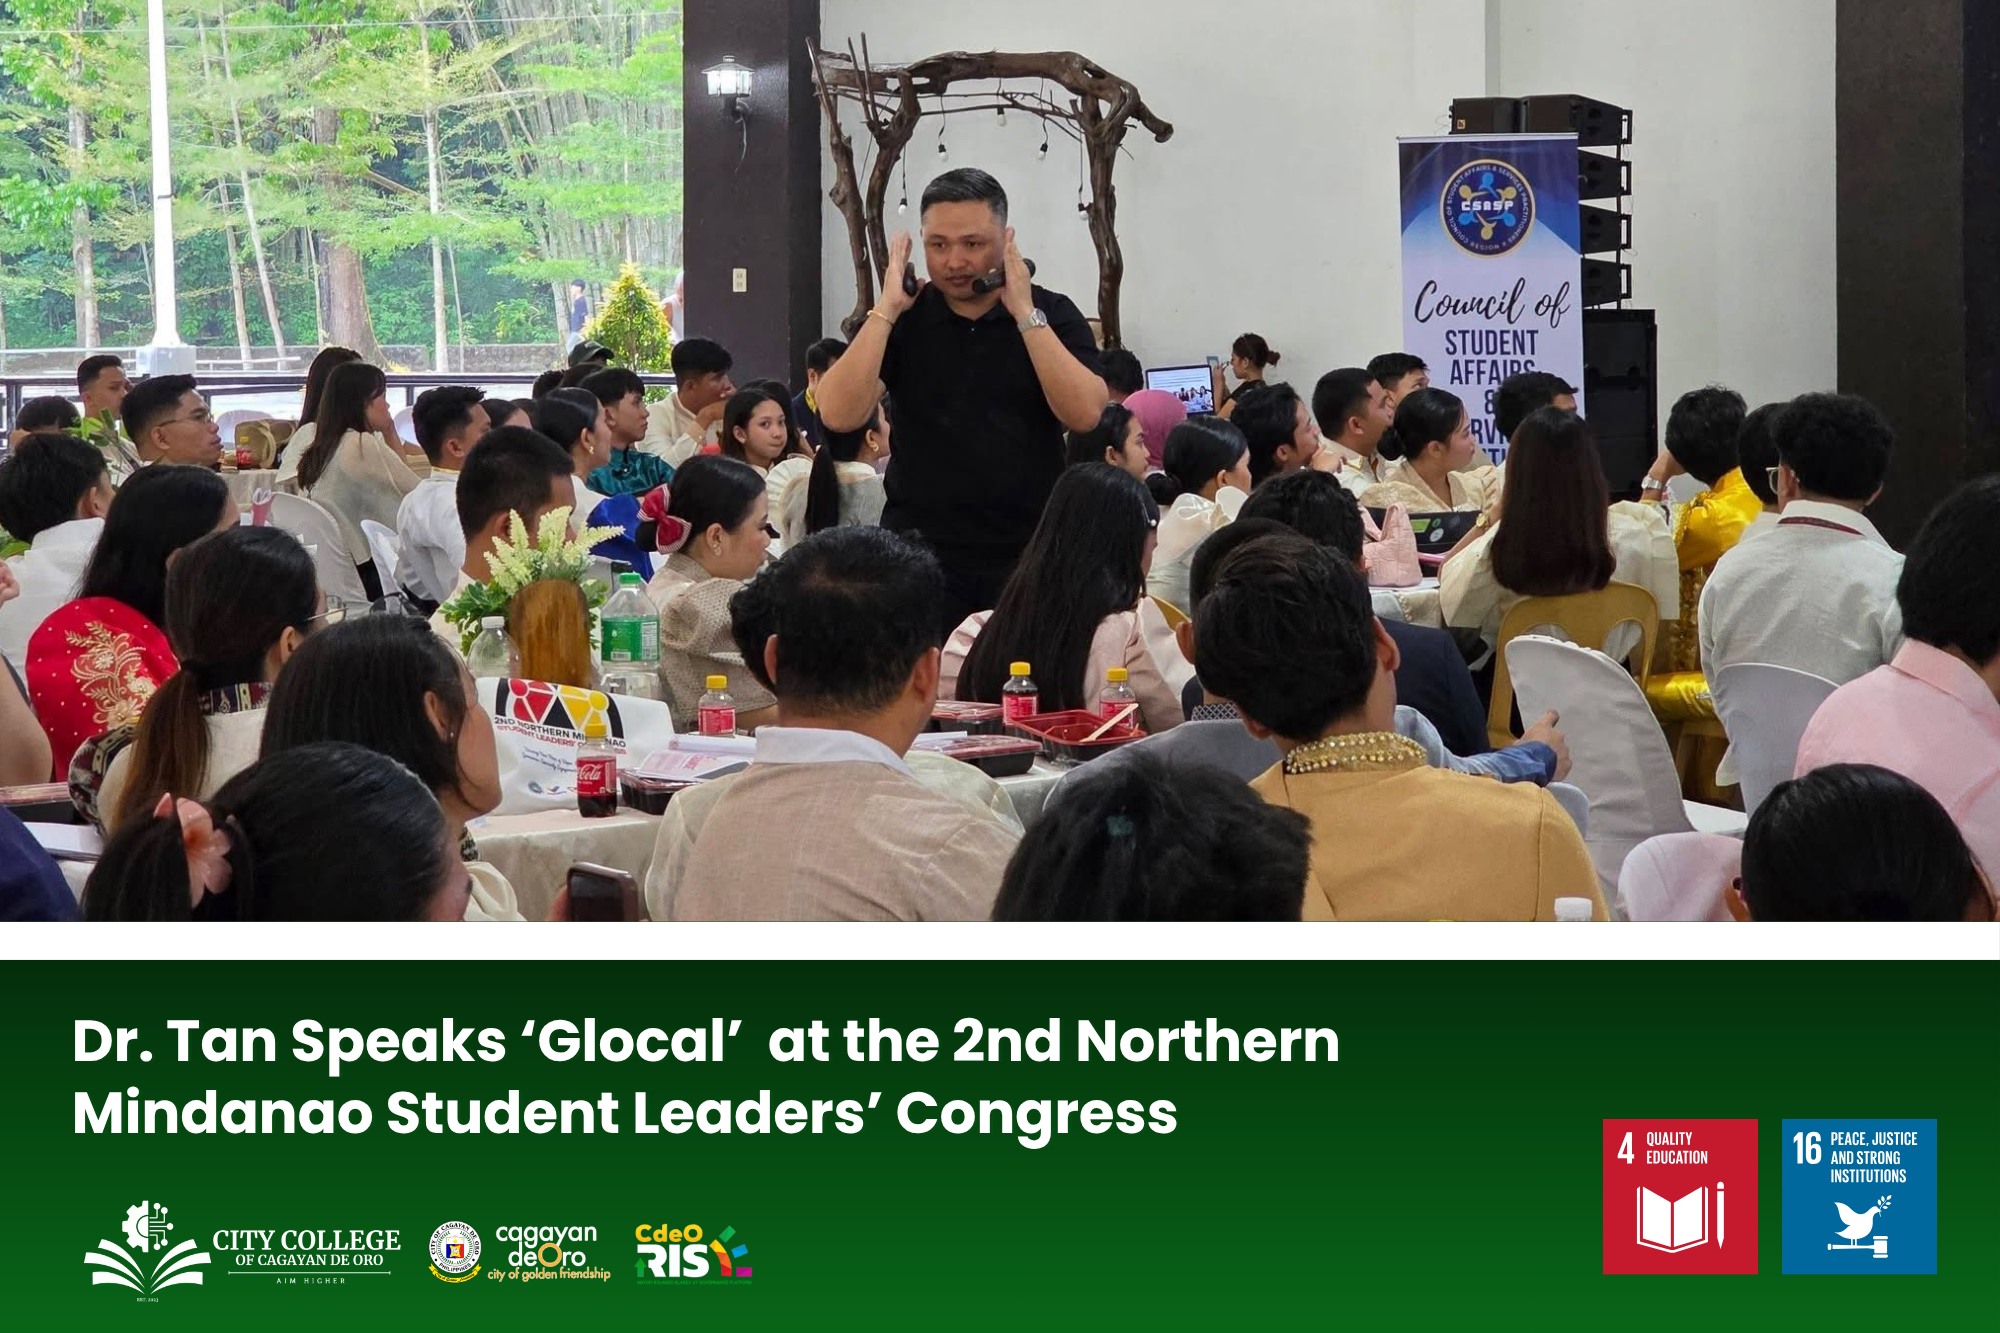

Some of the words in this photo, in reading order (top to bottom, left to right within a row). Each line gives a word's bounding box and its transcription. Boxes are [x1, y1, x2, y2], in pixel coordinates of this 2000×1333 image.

[1464, 165, 1491, 178] AFFAIRS
[1498, 166, 1524, 192] SERVICES
[1447, 175, 1464, 204] STUDENT
[1461, 200, 1514, 212] CSASP
[1449, 217, 1469, 244] COUNCIL
[1414, 277, 1526, 325] Council
[1534, 281, 1571, 329] of
[1445, 329, 1539, 356] STUDENT
[494, 716, 516, 726] 2ND
[517, 721, 570, 738] NORTHERN
[572, 731, 627, 748] MINAO
[496, 725, 536, 738] STUDENT
